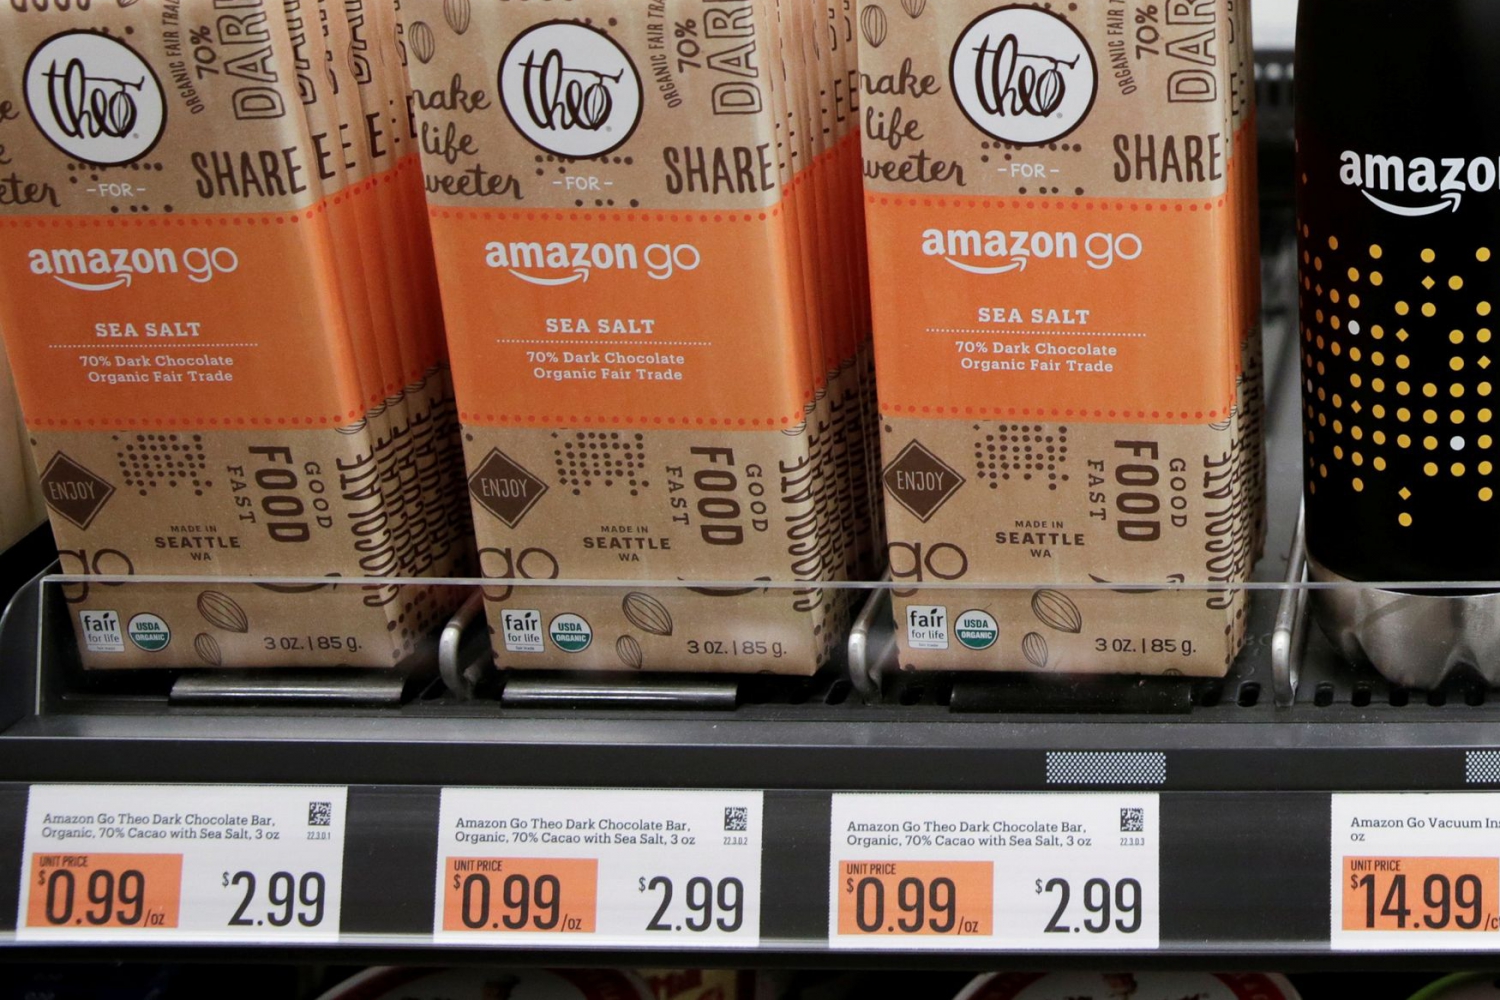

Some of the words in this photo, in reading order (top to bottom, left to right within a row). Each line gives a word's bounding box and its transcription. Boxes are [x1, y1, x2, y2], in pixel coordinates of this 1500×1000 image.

[1107, 9, 1125, 35] FAIR
[1135, 4, 1159, 60] 70%
[674, 18, 700, 74] 70%
[972, 33, 1080, 118] theo
[1108, 40, 1137, 95] ORGANIC
[41, 58, 145, 139] theo
[518, 49, 625, 131] theo
[866, 106, 924, 150] life
[422, 121, 479, 164] life
[1112, 132, 1222, 183] SHARE
[191, 147, 307, 200] SHARE
[663, 142, 775, 194] SHARE
[862, 149, 967, 186] weeter
[1010, 164, 1045, 178] FOR
[922, 228, 1078, 258] amazon
[1085, 232, 1142, 269] go
[28, 247, 177, 274] amazon
[182, 247, 238, 282] go
[485, 241, 637, 269] amazon
[644, 243, 700, 279] go
[978, 307, 1023, 323] SEA
[1031, 309, 1090, 325] SALT
[95, 323, 139, 337] SEA
[145, 323, 201, 337] SALT
[546, 318, 590, 333] SEA
[597, 319, 655, 334] SALT
[955, 341, 988, 354] 70%
[992, 342, 1030, 355] Dark
[1035, 343, 1117, 356] Chocolate
[79, 355, 112, 367] 70%
[115, 355, 151, 367] Dark
[155, 354, 233, 367] Chocolate
[526, 351, 559, 363] 70%
[563, 352, 600, 364] Dark
[604, 352, 684, 365] Chocolate
[961, 357, 1025, 373] Organic
[1030, 359, 1061, 371] Fair
[1064, 360, 1113, 373] Trade
[88, 370, 151, 385] Organic
[154, 370, 183, 382] Fair
[187, 370, 233, 382] Trade
[534, 368, 597, 382] Organic
[601, 368, 631, 380] Fair
[635, 369, 682, 381] Trade
[482, 477, 527, 498] ENJOY
[897, 470, 944, 491] ENJOY
[49, 480, 97, 501] ENJOY
[249, 445, 311, 543] FOOD
[690, 446, 744, 546] FOOD
[1088, 459, 1106, 521] FAST
[1114, 440, 1161, 542] FOOD
[1169, 458, 1187, 528] GOOD
[1015, 520, 1045, 529] MADE
[1051, 521, 1064, 529] IN
[155, 536, 240, 549] SEATTLE
[583, 537, 671, 551] SEATTLE
[996, 532, 1085, 546] SEATTLE
[1031, 549, 1051, 558] WA
[964, 619, 988, 628] USDA
[961, 631, 992, 639] ORGANIC
[1095, 638, 1107, 651] 3
[43, 813, 94, 827] Amazon
[97, 813, 116, 826] Go
[118, 813, 150, 826] Theo
[152, 814, 181, 826] Dark
[185, 814, 248, 827] Chocolate
[251, 814, 275, 828] Bar,
[847, 821, 899, 833] Amazon
[902, 821, 922, 833] Go
[924, 821, 956, 833] Theo
[959, 821, 990, 833] Dark
[992, 822, 1058, 834] Chocolate
[1061, 822, 1087, 835] Bar,
[1350, 817, 1404, 829] Amazon
[1406, 817, 1426, 829] Go
[1429, 817, 1482, 829] Vacuum
[847, 834, 902, 848] Organic,
[905, 835, 932, 847] 70%
[935, 835, 976, 847] Cacao
[979, 835, 1006, 847] with
[1009, 835, 1032, 847] Sea
[1034, 835, 1063, 848] Salt,
[1066, 835, 1075, 847] 3
[1077, 838, 1092, 848] oz
[1350, 833, 1366, 842] oz
[846, 863, 868, 875] UNIT
[870, 863, 896, 875] PRICE
[1350, 860, 1372, 871] UNIT
[1374, 860, 1400, 871] PRICE
